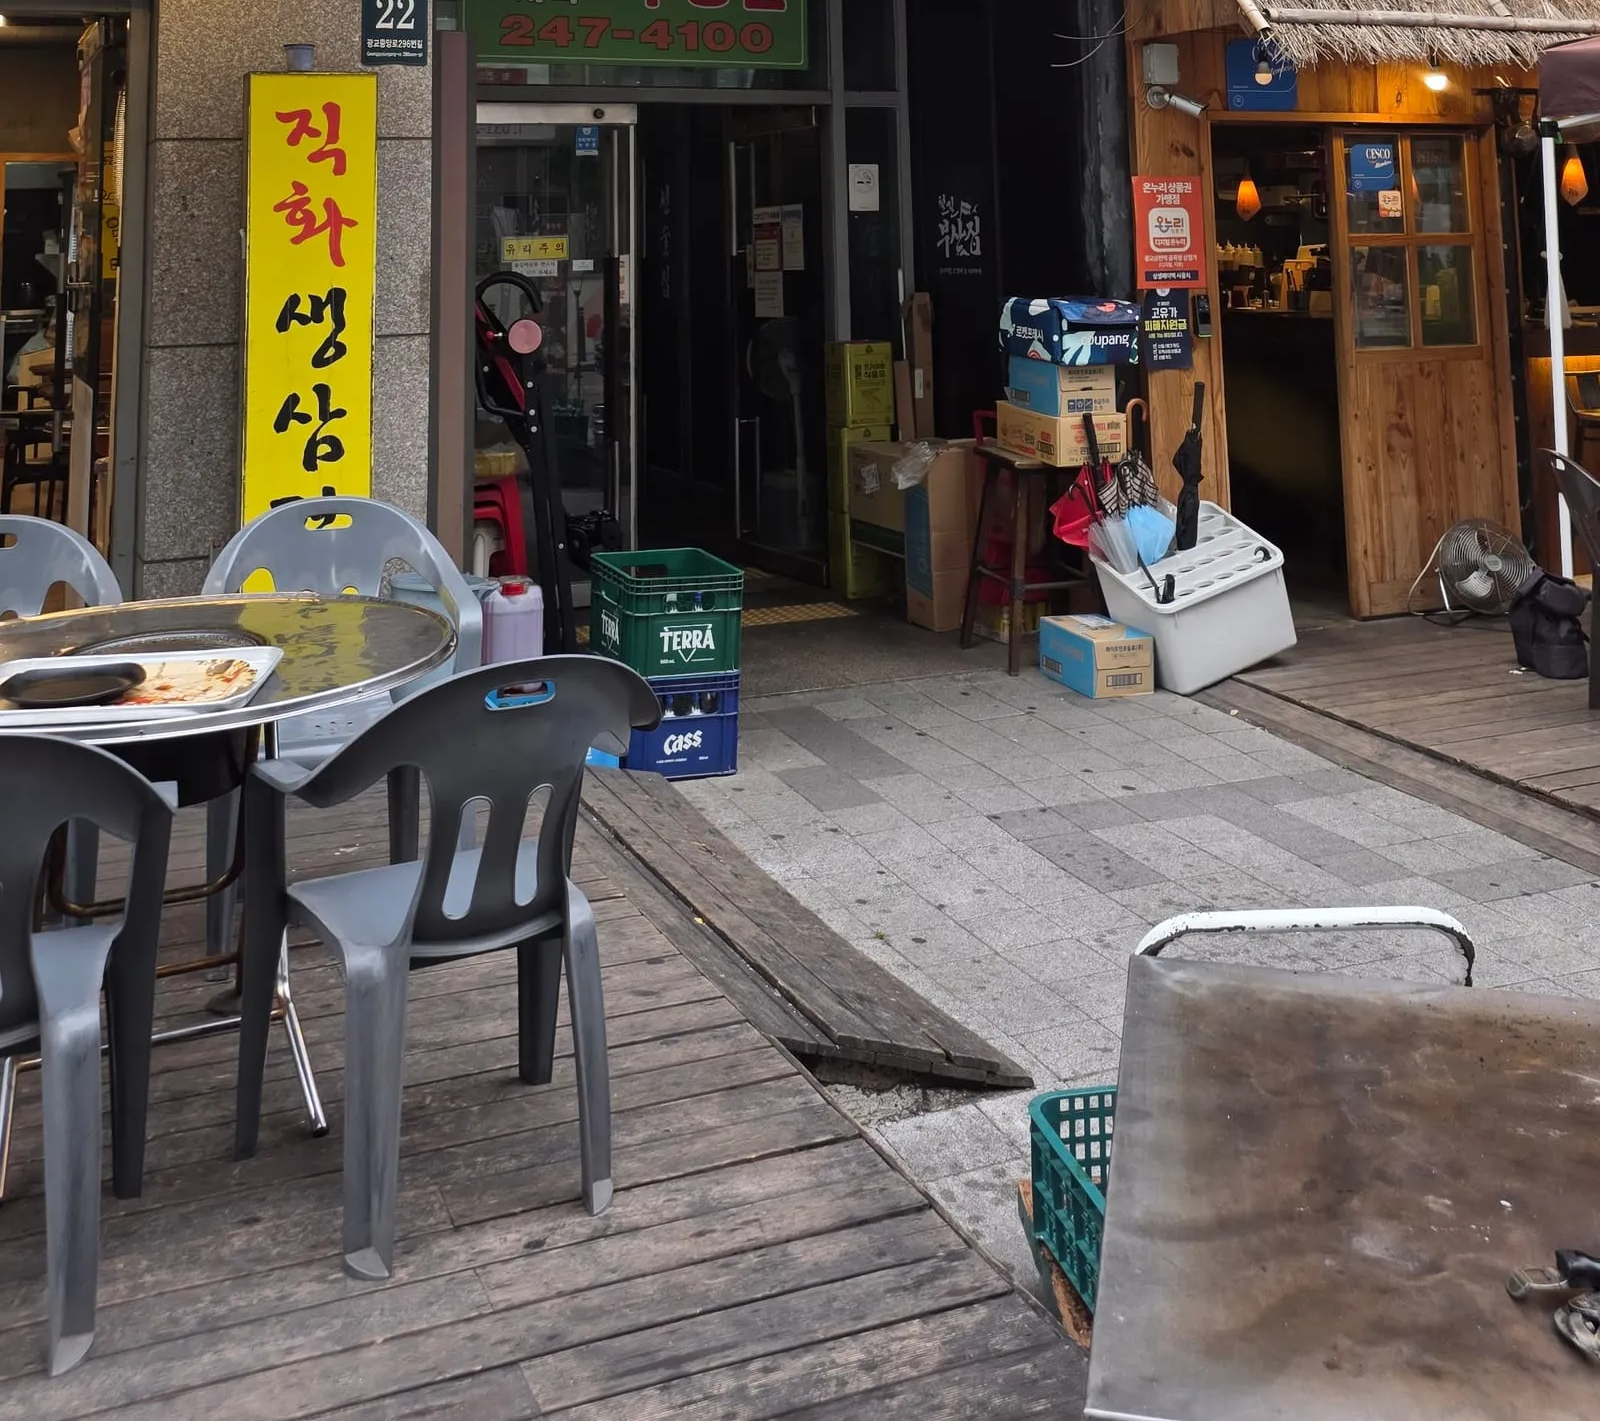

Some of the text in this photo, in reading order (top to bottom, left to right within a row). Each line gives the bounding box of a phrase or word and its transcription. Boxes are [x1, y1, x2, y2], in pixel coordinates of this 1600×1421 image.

[498, 14, 775, 54] 247-4100
[1365, 147, 1391, 160] CESCO
[1151, 306, 1178, 319] 고유가
[601, 611, 620, 646] TERRA
[659, 628, 716, 653] TERRA
[663, 729, 703, 756] Cass
